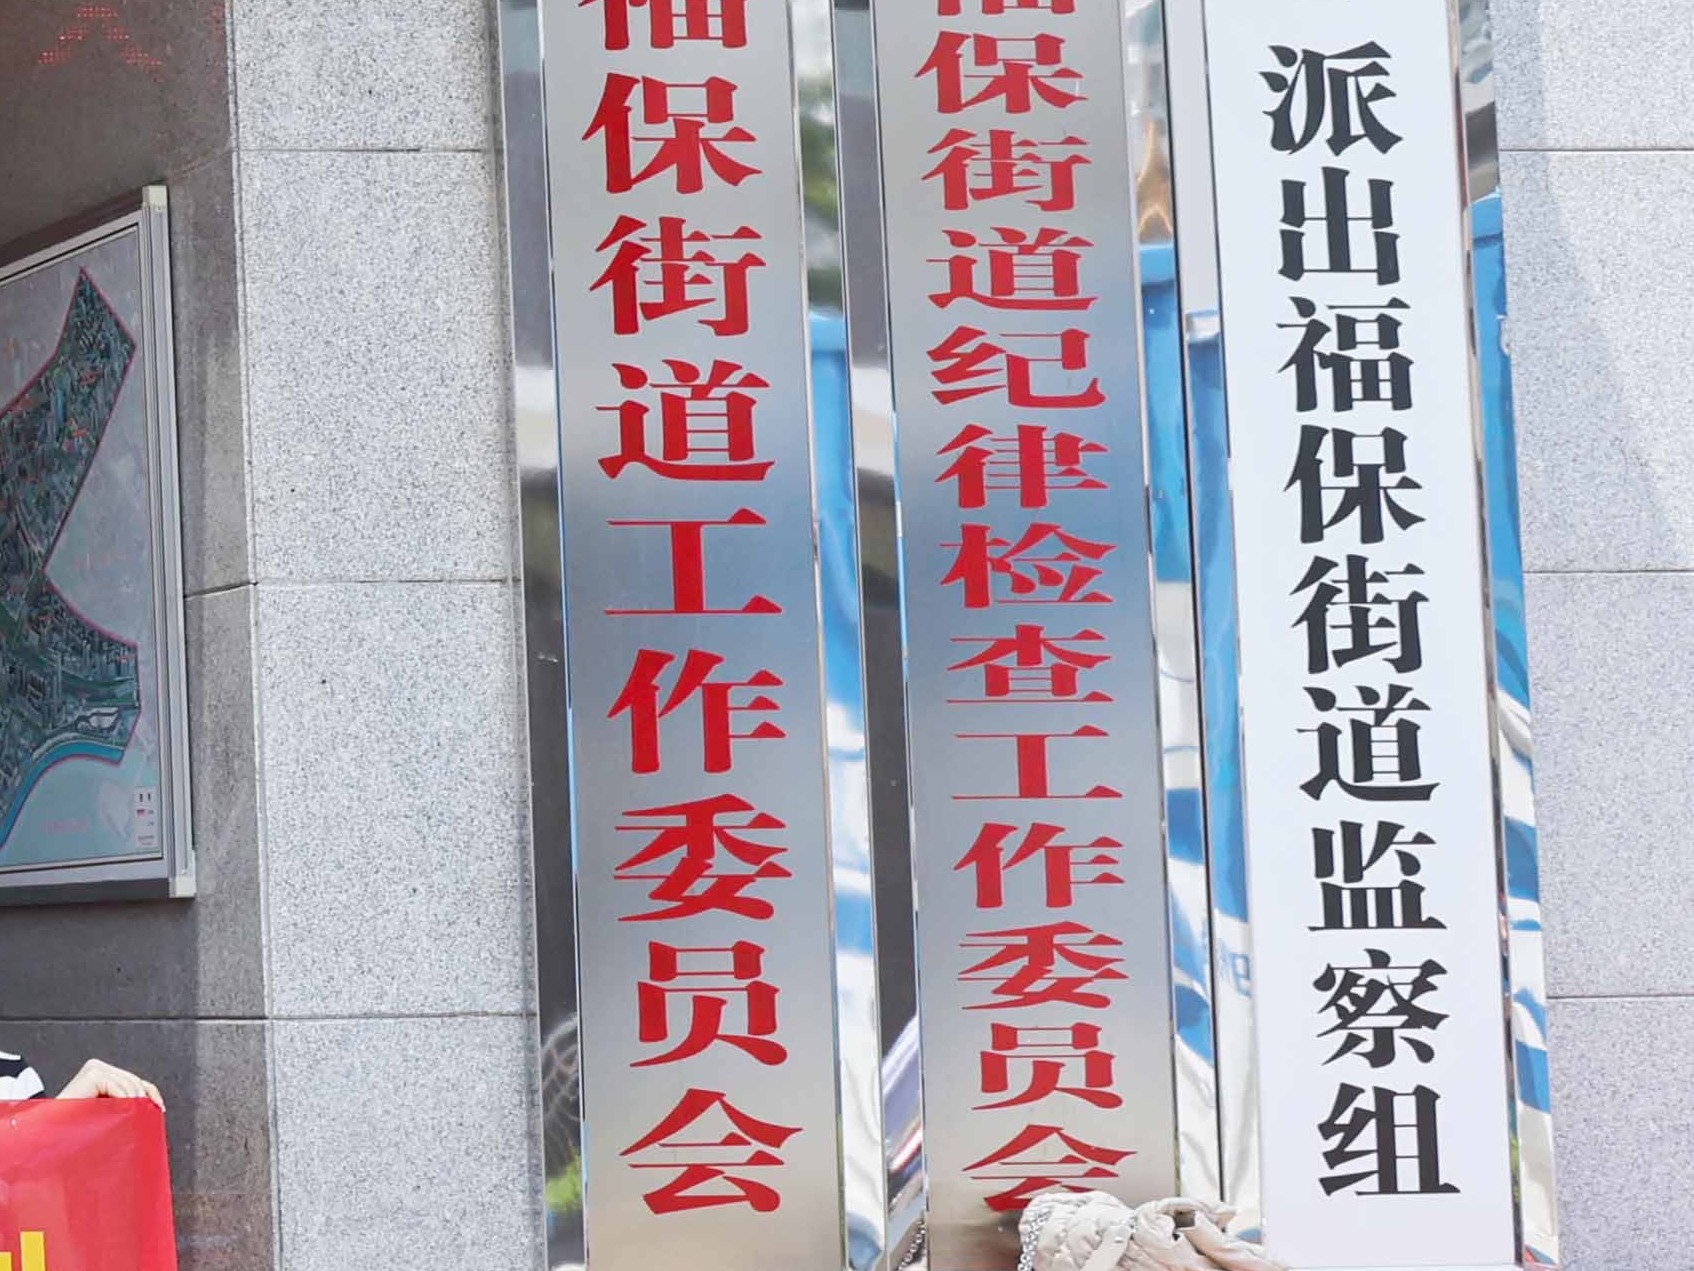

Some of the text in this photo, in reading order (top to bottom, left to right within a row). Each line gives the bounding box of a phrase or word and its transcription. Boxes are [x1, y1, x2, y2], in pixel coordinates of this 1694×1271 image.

[1259, 41, 1459, 1196] 派出福保街道监察组
